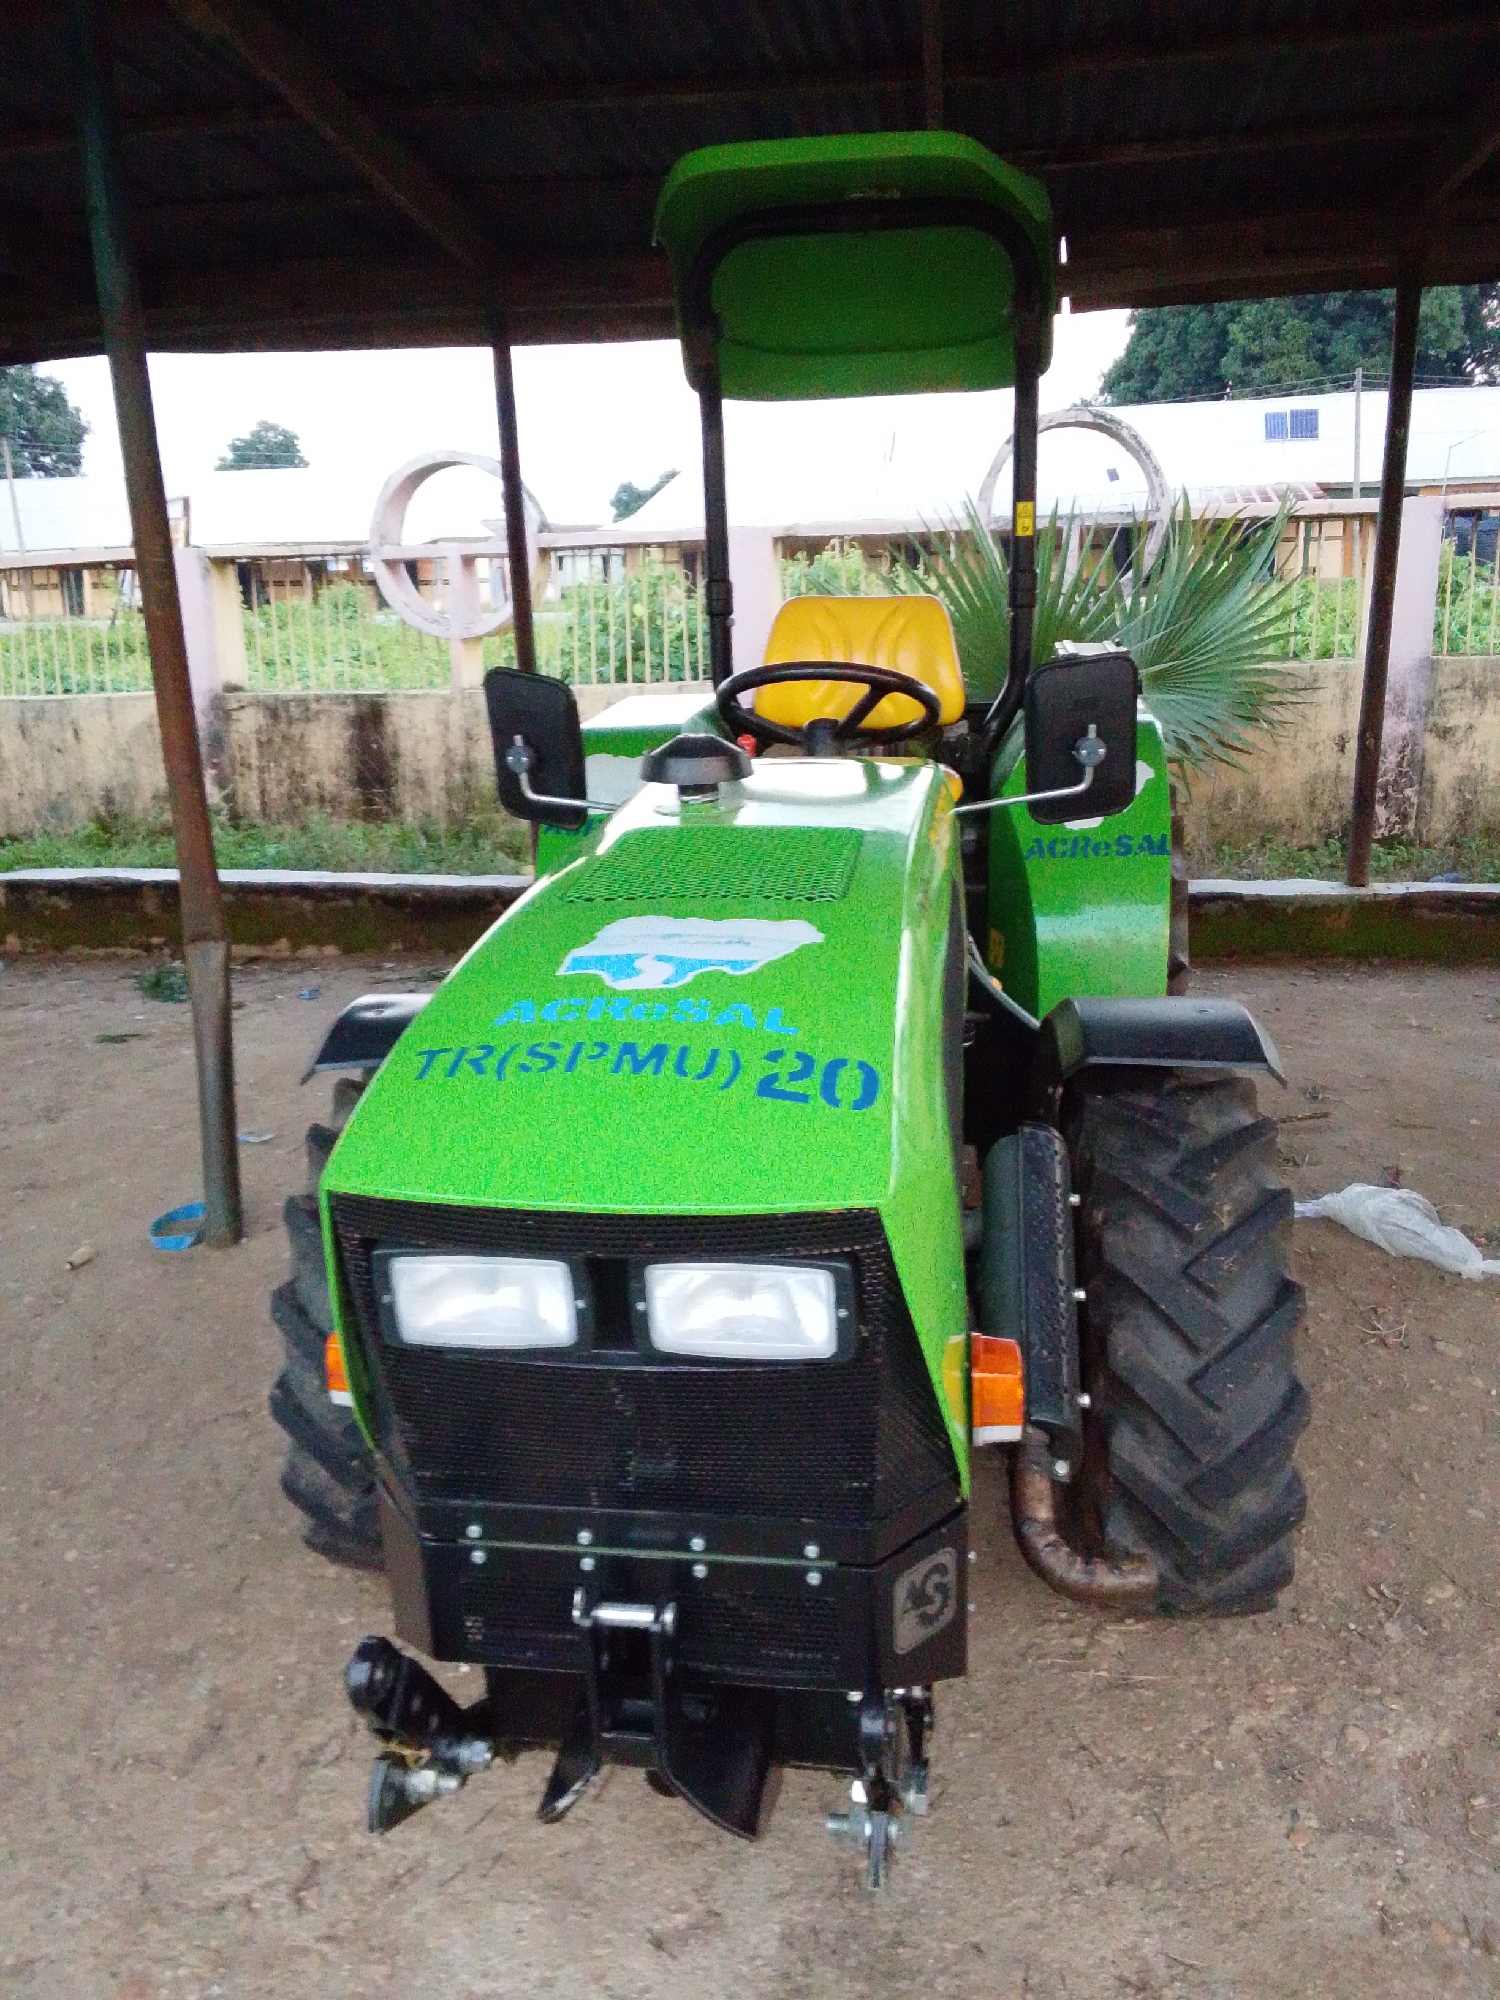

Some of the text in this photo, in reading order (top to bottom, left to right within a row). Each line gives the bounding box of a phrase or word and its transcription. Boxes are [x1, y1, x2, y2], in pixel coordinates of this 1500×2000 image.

[1024, 833, 1171, 861] ACReSAL
[493, 996, 800, 1036] ACReSAL
[756, 1048, 881, 1111] 20
